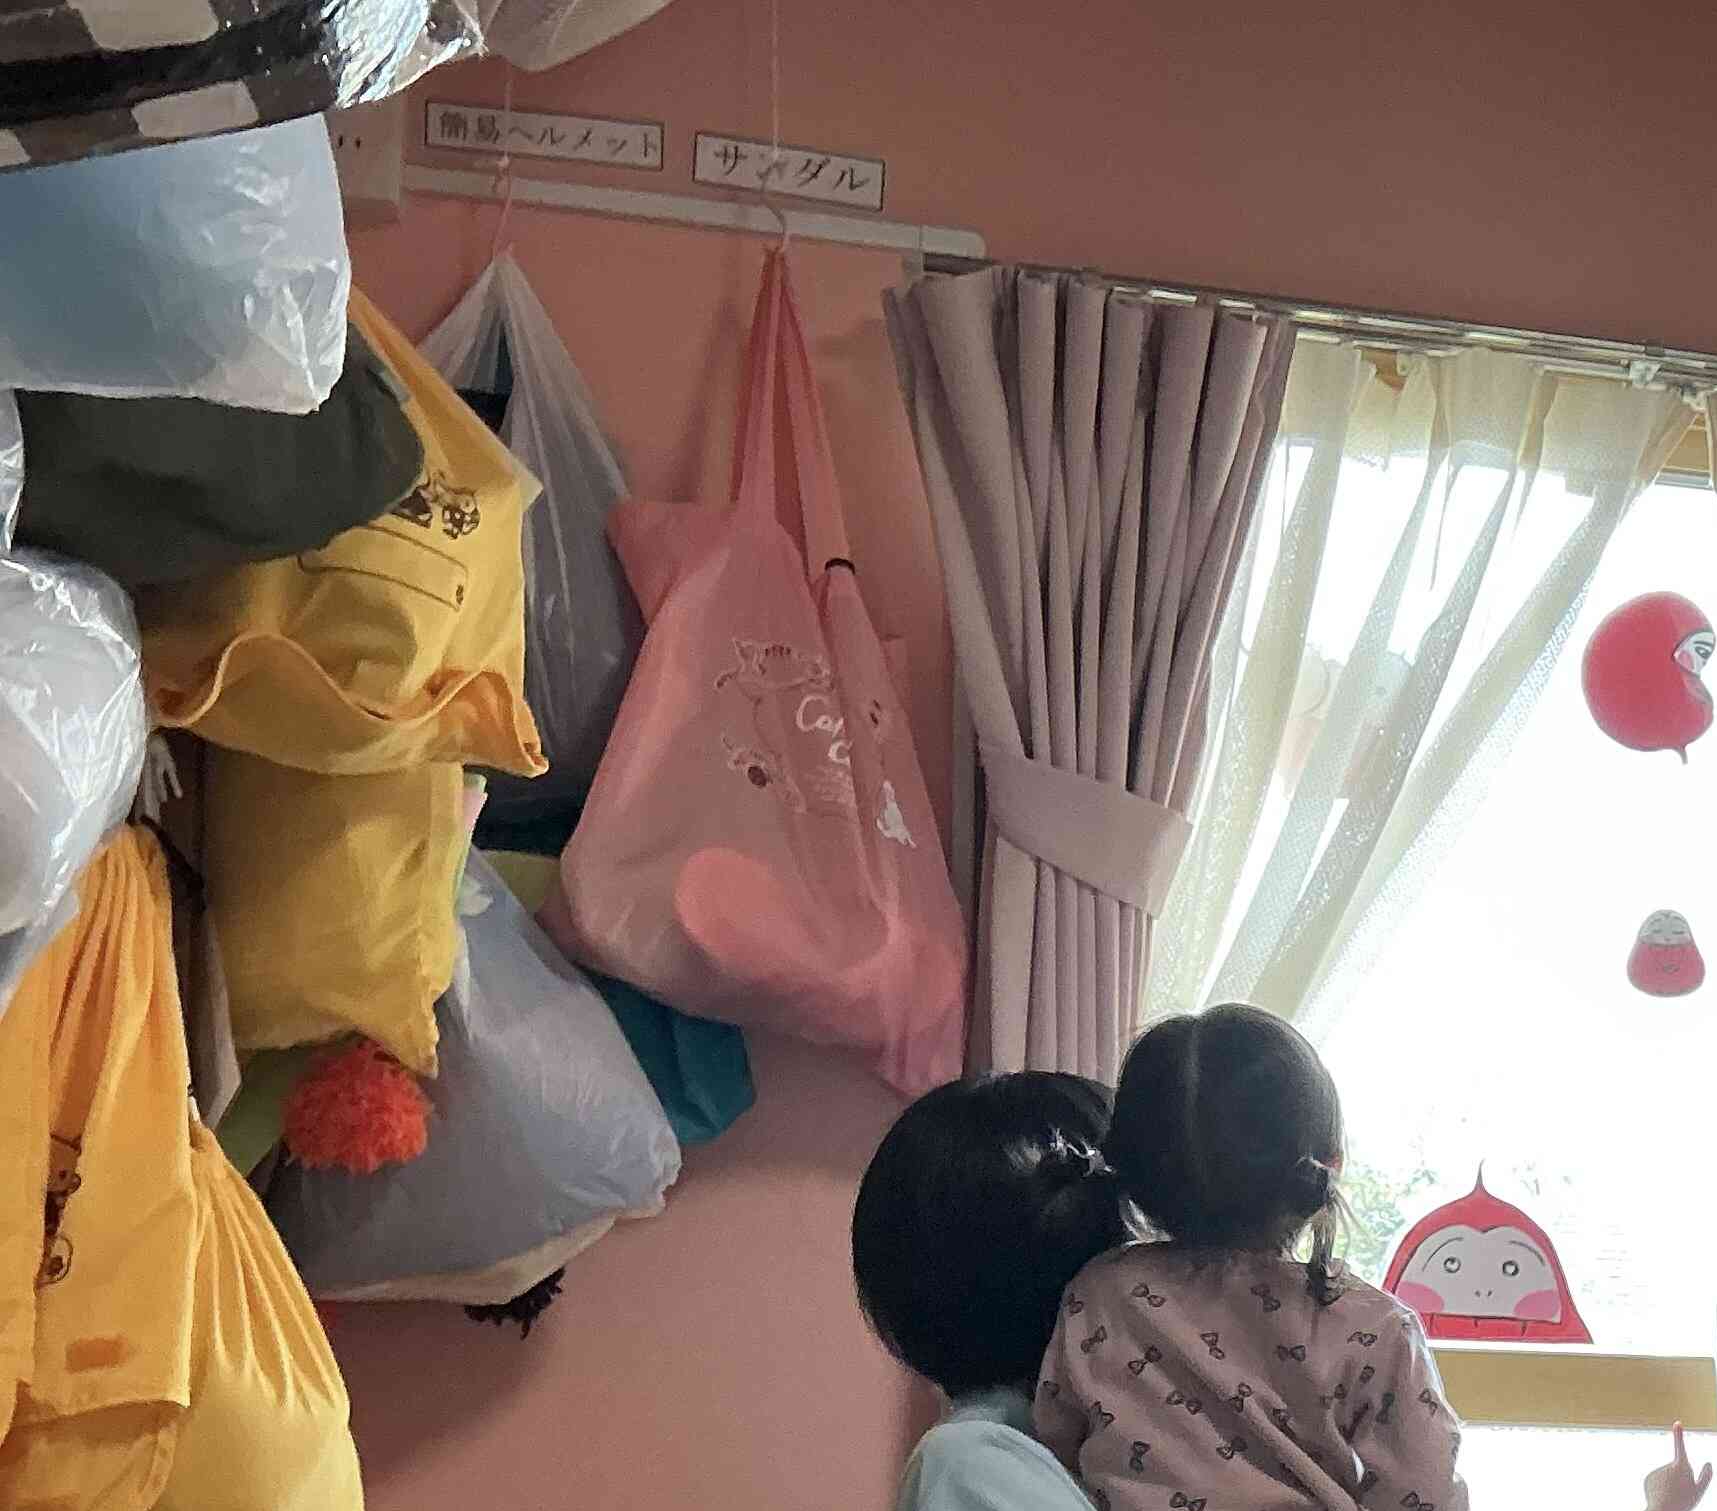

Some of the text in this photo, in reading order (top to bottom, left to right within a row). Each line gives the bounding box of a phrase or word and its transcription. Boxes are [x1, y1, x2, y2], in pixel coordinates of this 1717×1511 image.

[439, 110, 658, 158] 簡易ヘルメット
